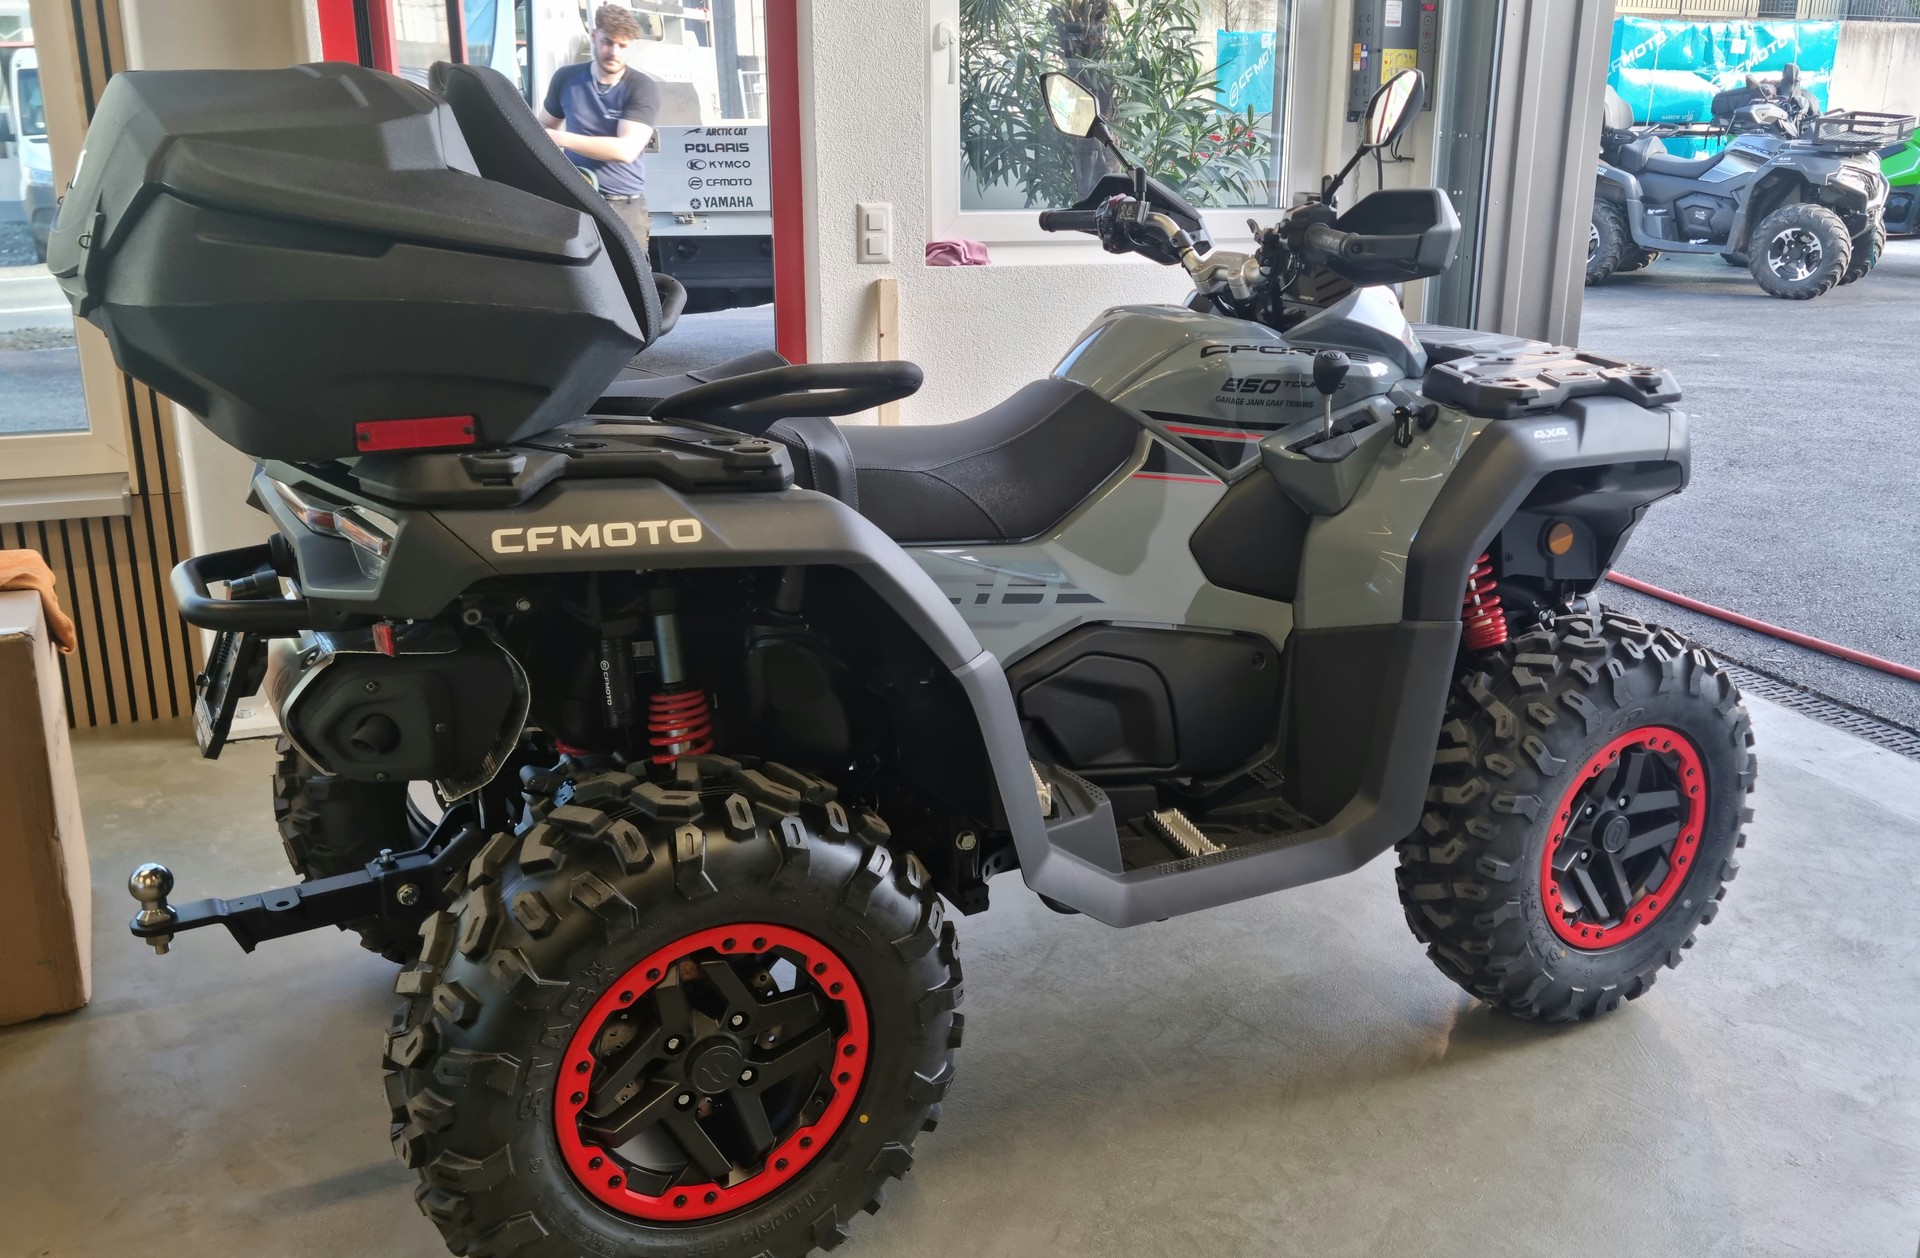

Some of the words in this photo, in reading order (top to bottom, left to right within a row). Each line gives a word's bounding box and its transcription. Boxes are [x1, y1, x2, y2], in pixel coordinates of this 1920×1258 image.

[1607, 31, 1667, 76] FMOTO
[1239, 39, 1276, 89] CFMOT
[706, 128, 732, 136] ARCTIC
[734, 128, 748, 136] CAT
[685, 143, 749, 153] POLARIS
[709, 160, 751, 168] KYMCO
[706, 178, 752, 186] CFMOTO
[703, 196, 753, 208] YAMAHA
[1200, 345, 1369, 362] CFORE
[1221, 377, 1282, 394] 850
[1215, 395, 1245, 406] GARAGE
[1245, 398, 1264, 407] JANN
[1265, 399, 1284, 407] GRAF
[491, 518, 702, 554] CFMOTO
[603, 671, 613, 706] CFMOTO
